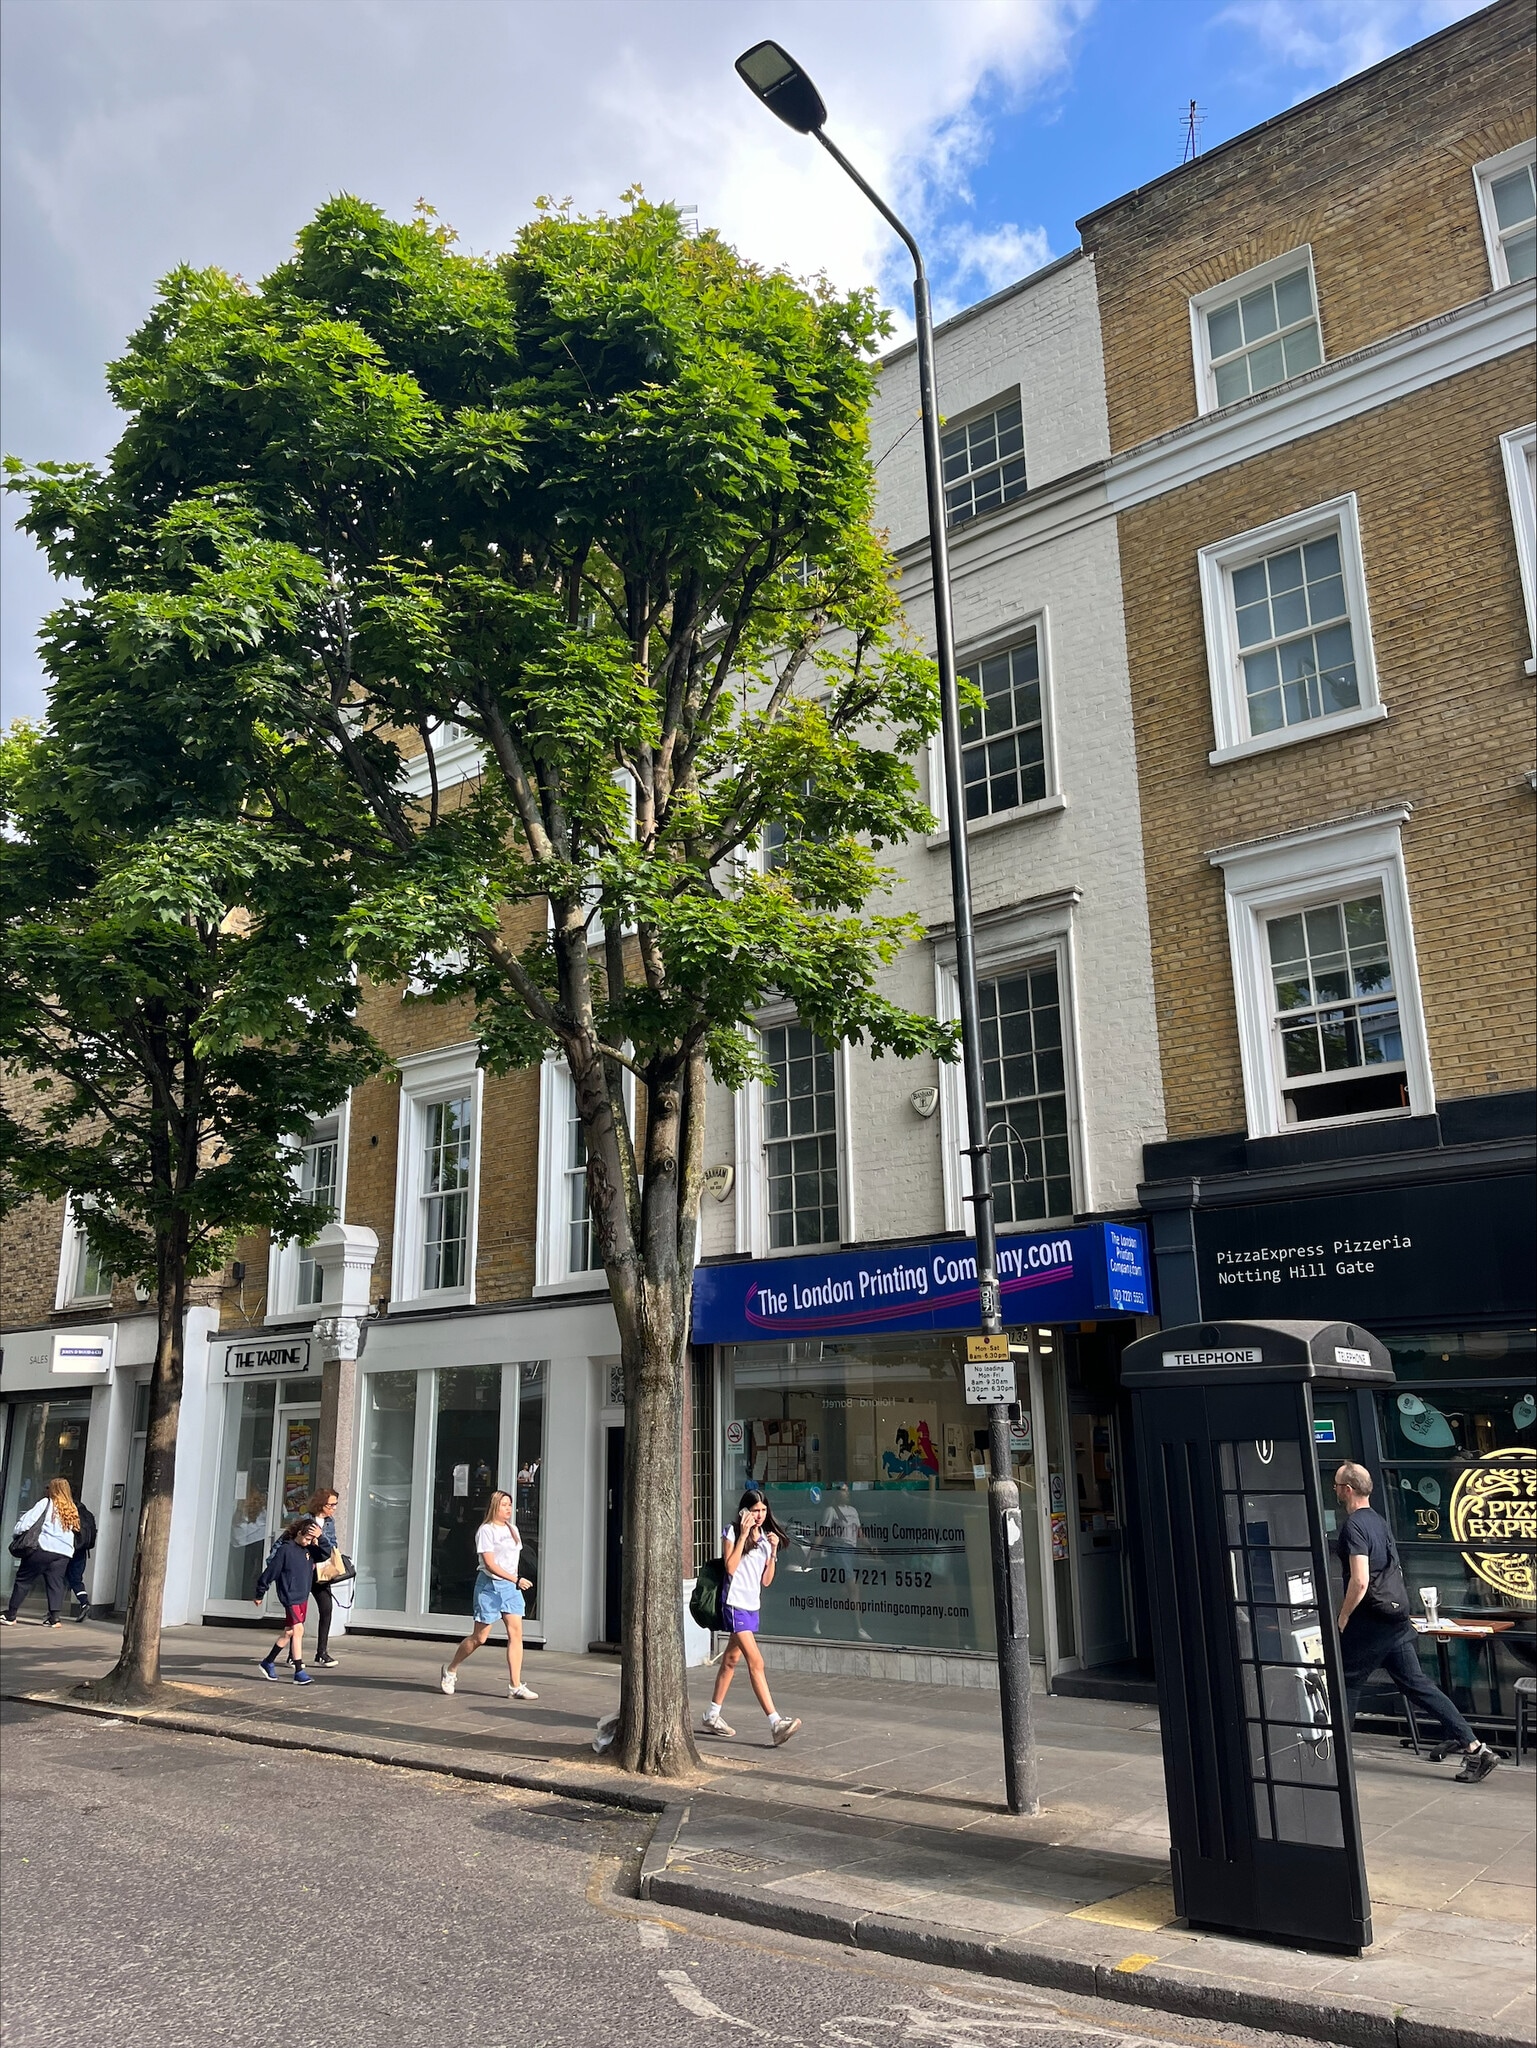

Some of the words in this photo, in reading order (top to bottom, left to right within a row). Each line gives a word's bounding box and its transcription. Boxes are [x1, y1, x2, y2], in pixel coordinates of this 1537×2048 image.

[1110, 1231, 1120, 1245] The
[1120, 1233, 1137, 1248] London
[1216, 1244, 1325, 1264] PizzaExpress
[1333, 1235, 1412, 1254] Pizzeria
[757, 1288, 788, 1316] The
[793, 1277, 854, 1310] London
[858, 1264, 929, 1295] Printing
[933, 1239, 1073, 1285] Comny.com
[1218, 1268, 1282, 1285] Notting
[1289, 1262, 1327, 1279] Hill
[1336, 1260, 1375, 1275] Gate
[1011, 1330, 1028, 1342] 135
[29, 1354, 49, 1365] SALES
[234, 1351, 255, 1368] THE
[256, 1347, 301, 1366] TARTINE
[1174, 1350, 1254, 1365] TELEPHONE
[1337, 1350, 1367, 1365] TELEPHONE
[984, 1365, 1004, 1373] loading
[1414, 1509, 1440, 1532] 19
[793, 1520, 811, 1537] The
[814, 1521, 847, 1538] London
[851, 1522, 889, 1542] Printing
[892, 1523, 965, 1544] Company.com
[820, 1567, 846, 1584] 020
[853, 1568, 887, 1586] 7221
[896, 1570, 932, 1588] 5552
[789, 1595, 970, 1620] nhg@thelondonprintingcompany.com
